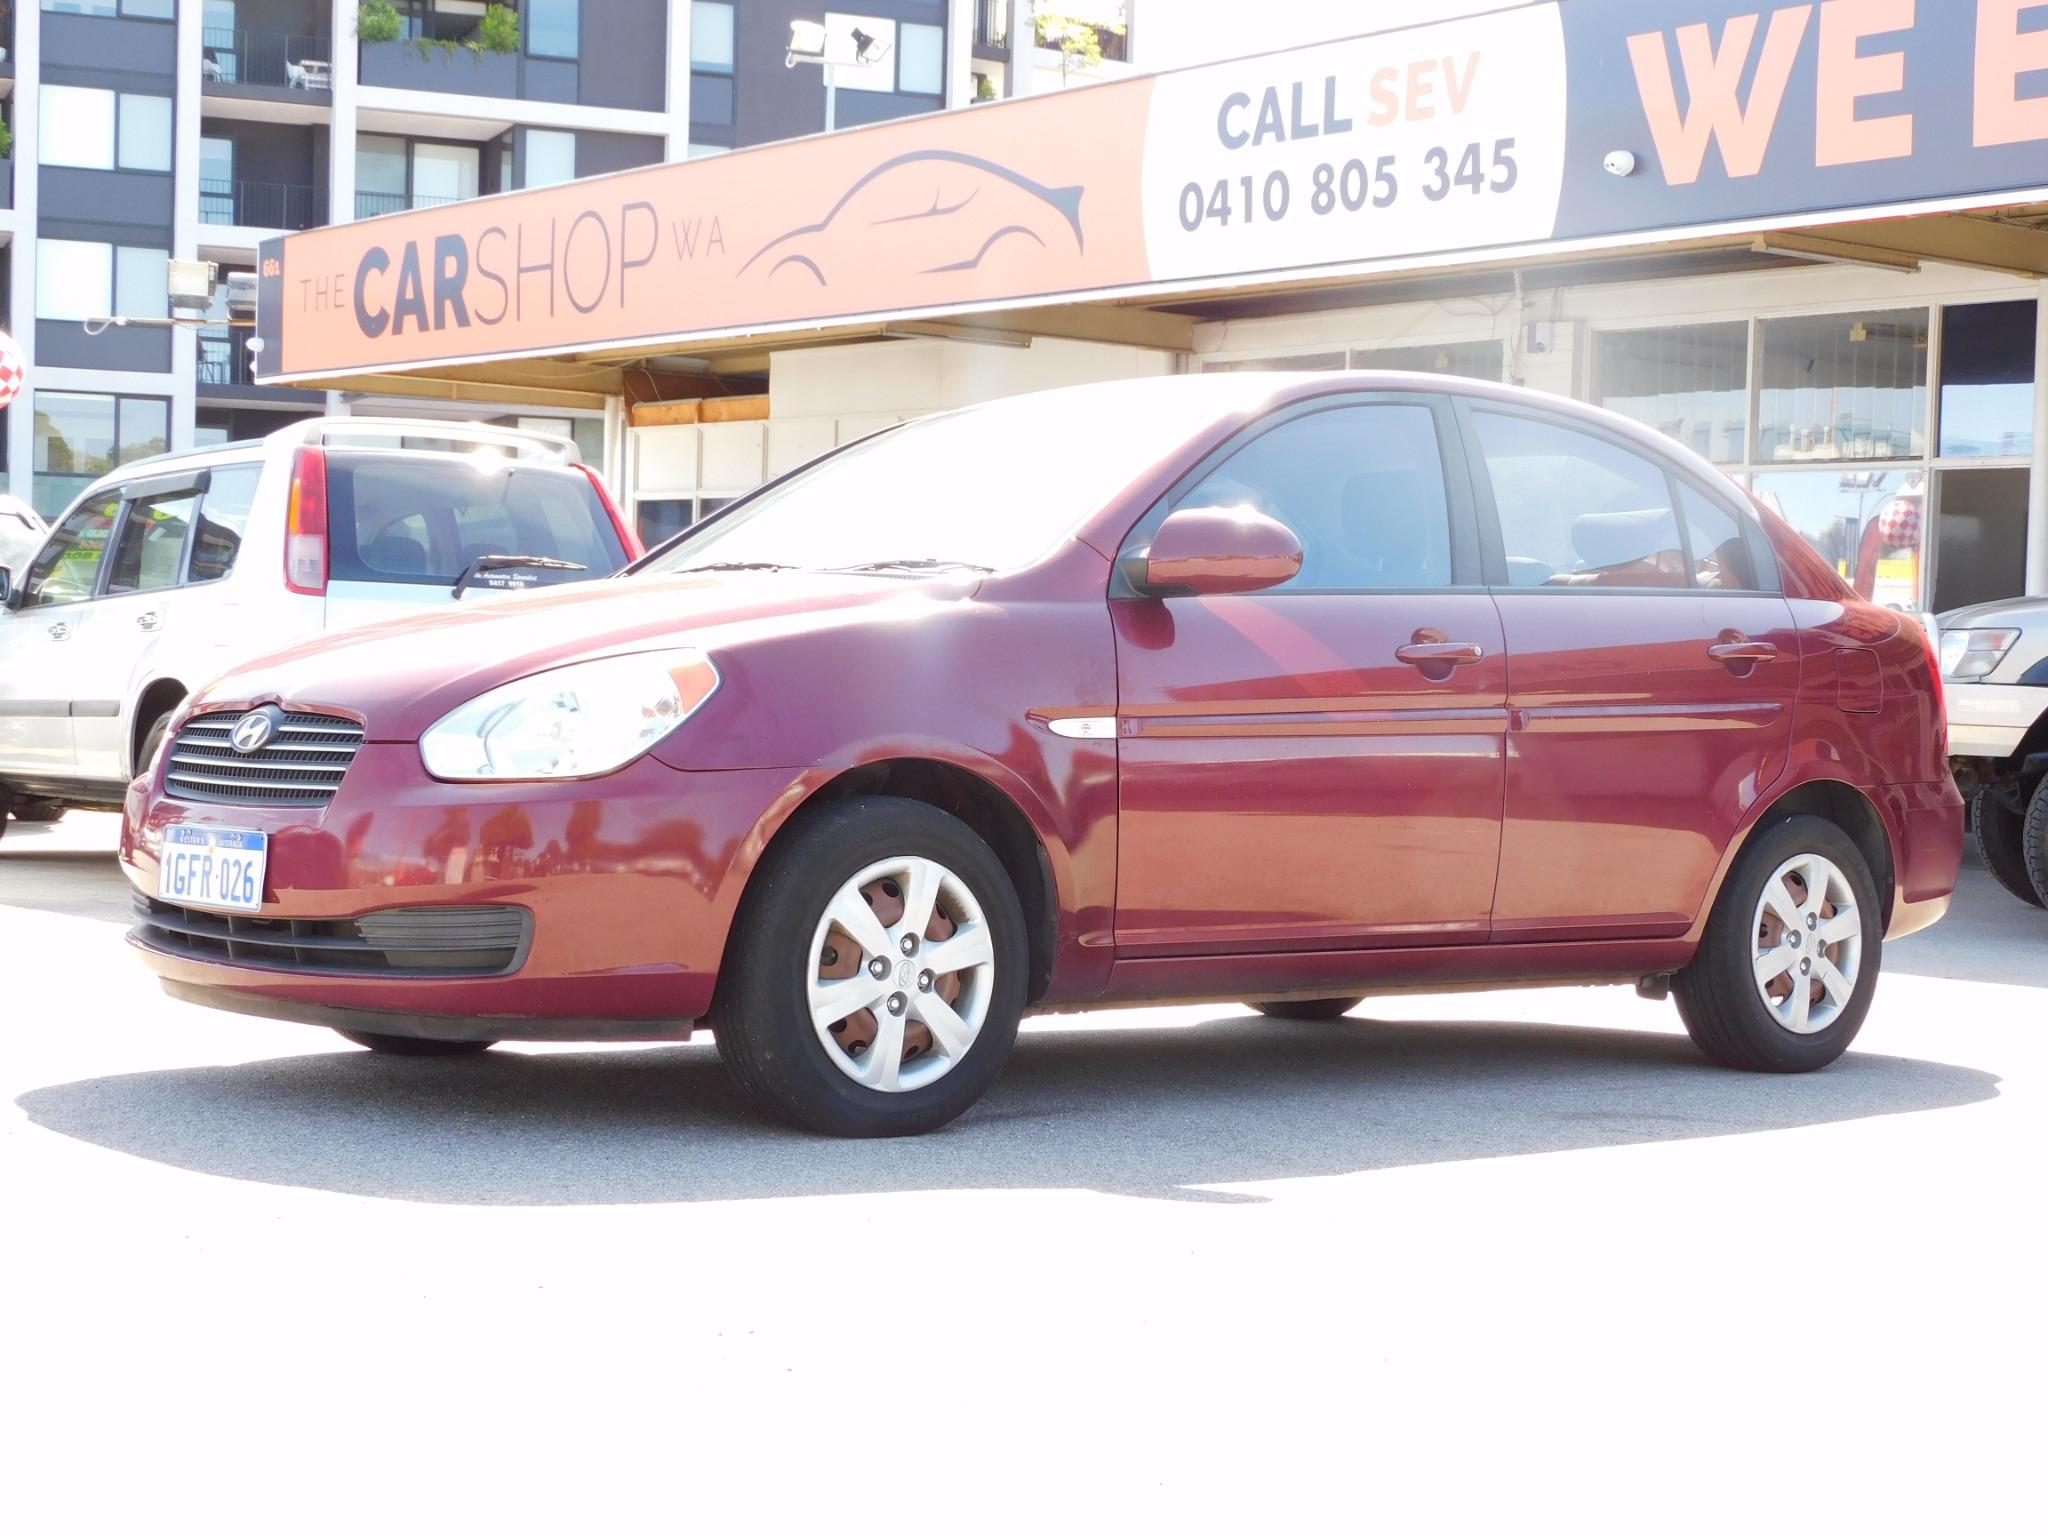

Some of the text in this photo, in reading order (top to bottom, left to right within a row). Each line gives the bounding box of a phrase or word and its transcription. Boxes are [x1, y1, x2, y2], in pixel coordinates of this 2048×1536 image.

[1217, 51, 1482, 150] CALL SEV
[1626, 0, 1915, 186] WE
[1179, 137, 1518, 232] 0410 805 345
[299, 273, 345, 313] THE
[671, 214, 727, 262] WA
